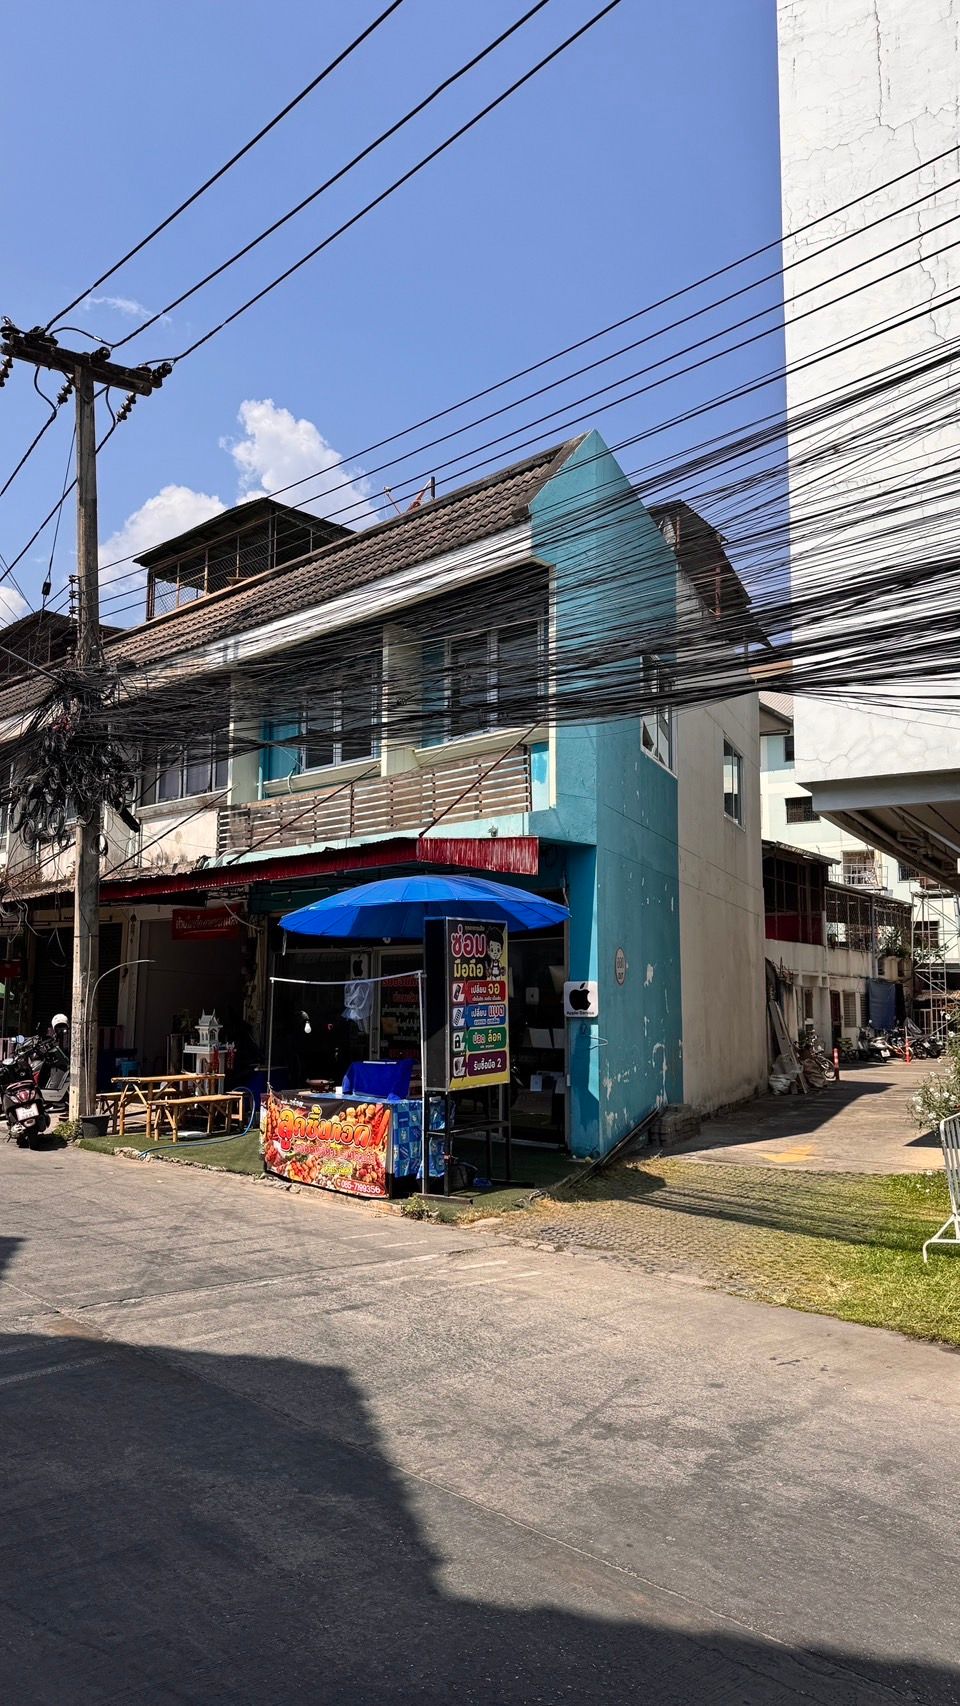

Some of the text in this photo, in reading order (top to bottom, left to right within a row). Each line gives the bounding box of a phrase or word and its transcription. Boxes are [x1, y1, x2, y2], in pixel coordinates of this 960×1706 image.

[451, 924, 486, 957] ซ่อม
[454, 959, 483, 977] มือถือ
[470, 982, 500, 994] เปลี่ยน จอ
[470, 1004, 505, 1018] เปลี่ยน แบต
[497, 1057, 502, 1068] 2
[278, 1104, 371, 1151] ลูกชิ้นทอด
